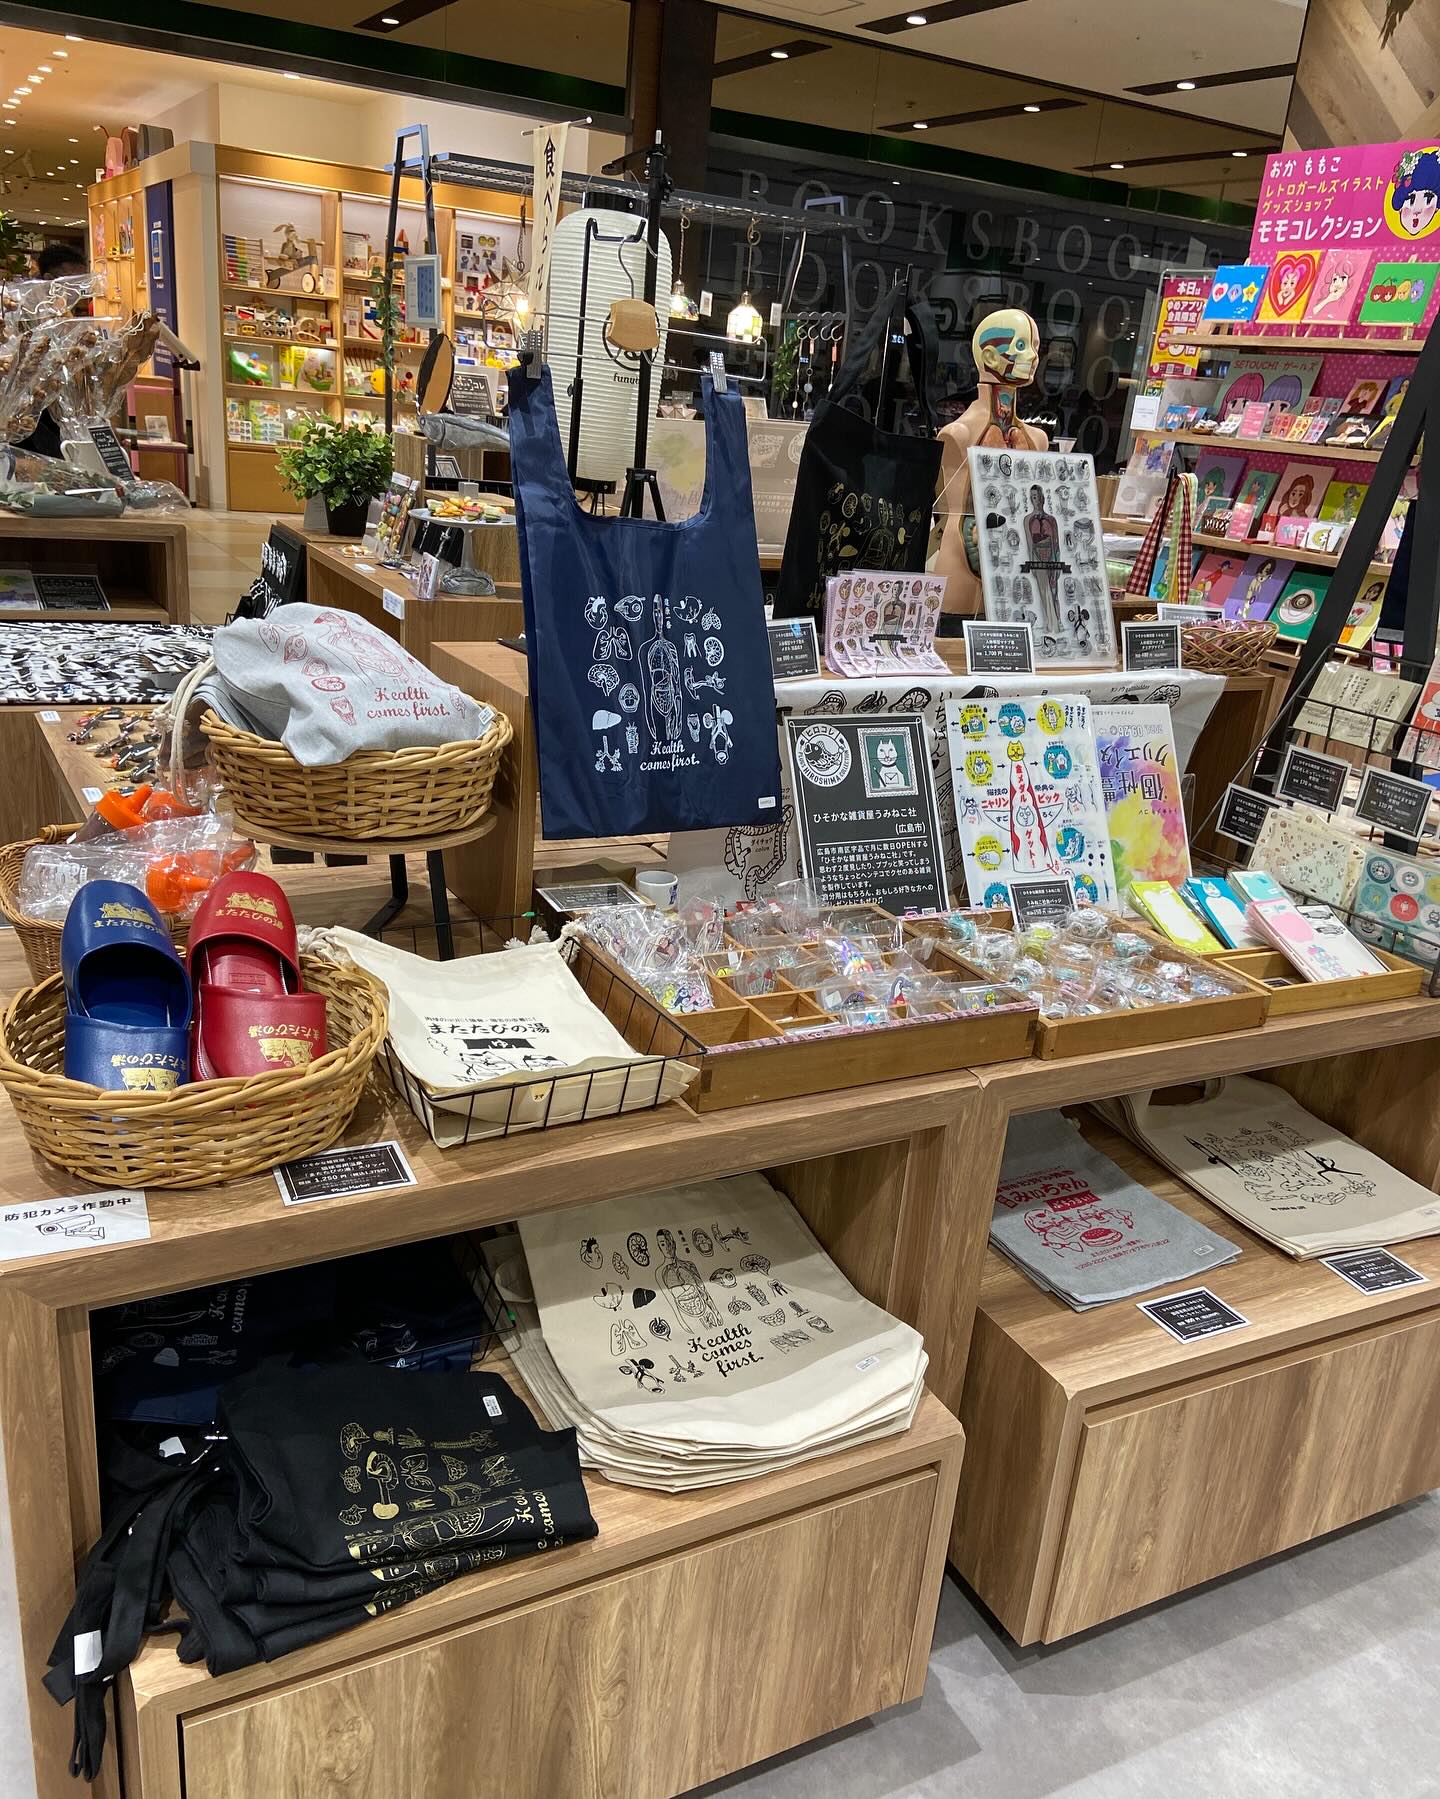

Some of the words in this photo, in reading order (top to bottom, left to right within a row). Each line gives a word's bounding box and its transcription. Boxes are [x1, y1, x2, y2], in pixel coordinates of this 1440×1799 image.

[1270, 159, 1297, 178] おか
[1304, 155, 1342, 175] ももこ
[1265, 176, 1385, 197] レトロガールズイラスト
[1261, 197, 1335, 215] グッズショップ
[1257, 216, 1383, 244] モモコレクション
[1177, 281, 1201, 296] 本日は
[1234, 360, 1279, 370] SETOUCHI
[374, 686, 430, 702] Health
[366, 705, 411, 720] comes
[411, 701, 451, 721] first.
[806, 726, 835, 736] ヒロコレ
[650, 739, 685, 755] Health
[639, 757, 671, 771] comes
[670, 753, 700, 772] first.
[803, 767, 842, 786] HIROSHIMA
[1015, 764, 1027, 803] 金メダル
[981, 797, 1009, 809] ニャリン
[1038, 793, 1060, 804] ピック
[813, 807, 918, 824] ひそかな雑貨屋うみねこ社
[895, 822, 926, 836] (広島市)
[817, 841, 929, 856] 広島市南区宇品で月に数日OPENする
[820, 850, 917, 864] 「ひそかな雑貨屋うみねこ社」です。
[820, 866, 931, 882] ようなちょっとヘンテコでクセのある雑貨
[822, 881, 872, 892] を製作しています。
[428, 1022, 551, 1035] またたびの湯
[314, 1174, 338, 1183] 1,250
[4, 1197, 132, 1222] 防犯カメラ作動中
[687, 1323, 752, 1354] Health
[701, 1338, 753, 1364] comes
[716, 1352, 765, 1378] first.
